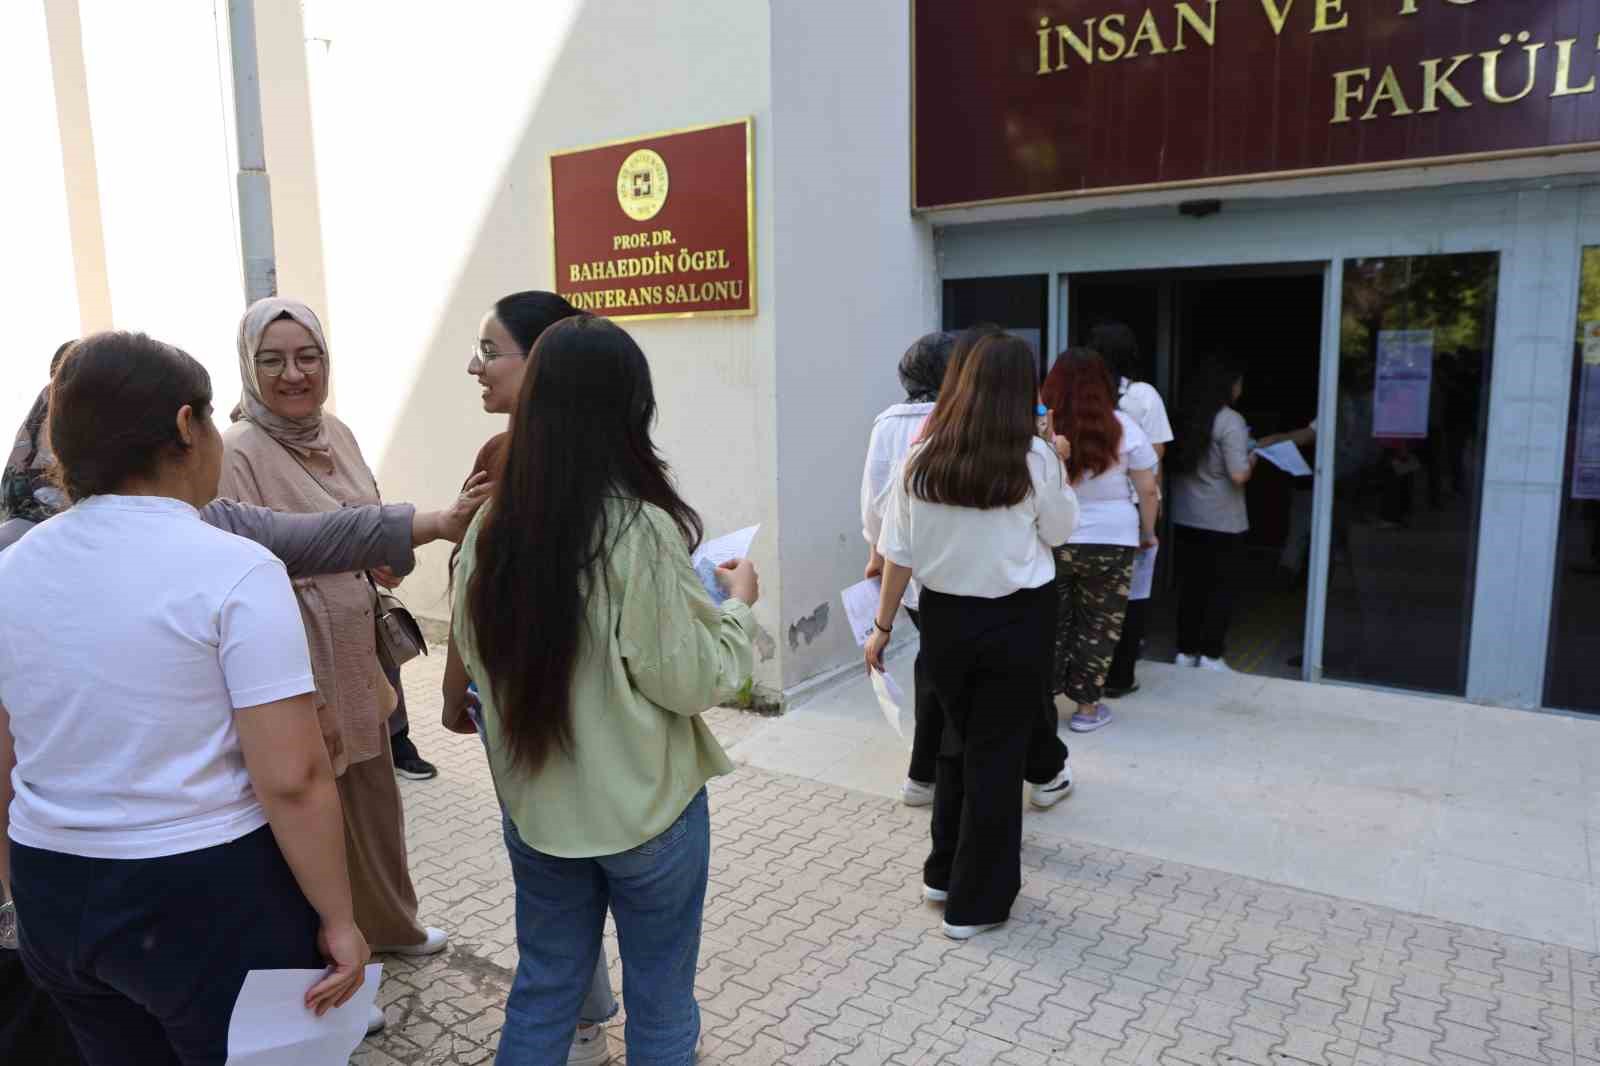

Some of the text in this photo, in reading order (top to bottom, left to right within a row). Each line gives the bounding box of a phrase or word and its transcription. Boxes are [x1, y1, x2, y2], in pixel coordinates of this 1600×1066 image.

[1037, 0, 1348, 75] İNSAN VE
[1329, 30, 1600, 123] FAKÜL
[613, 230, 676, 250] PROF. DR.
[569, 248, 729, 282] BAHAEDDİN ÖGEL
[666, 280, 743, 303] SALONU
